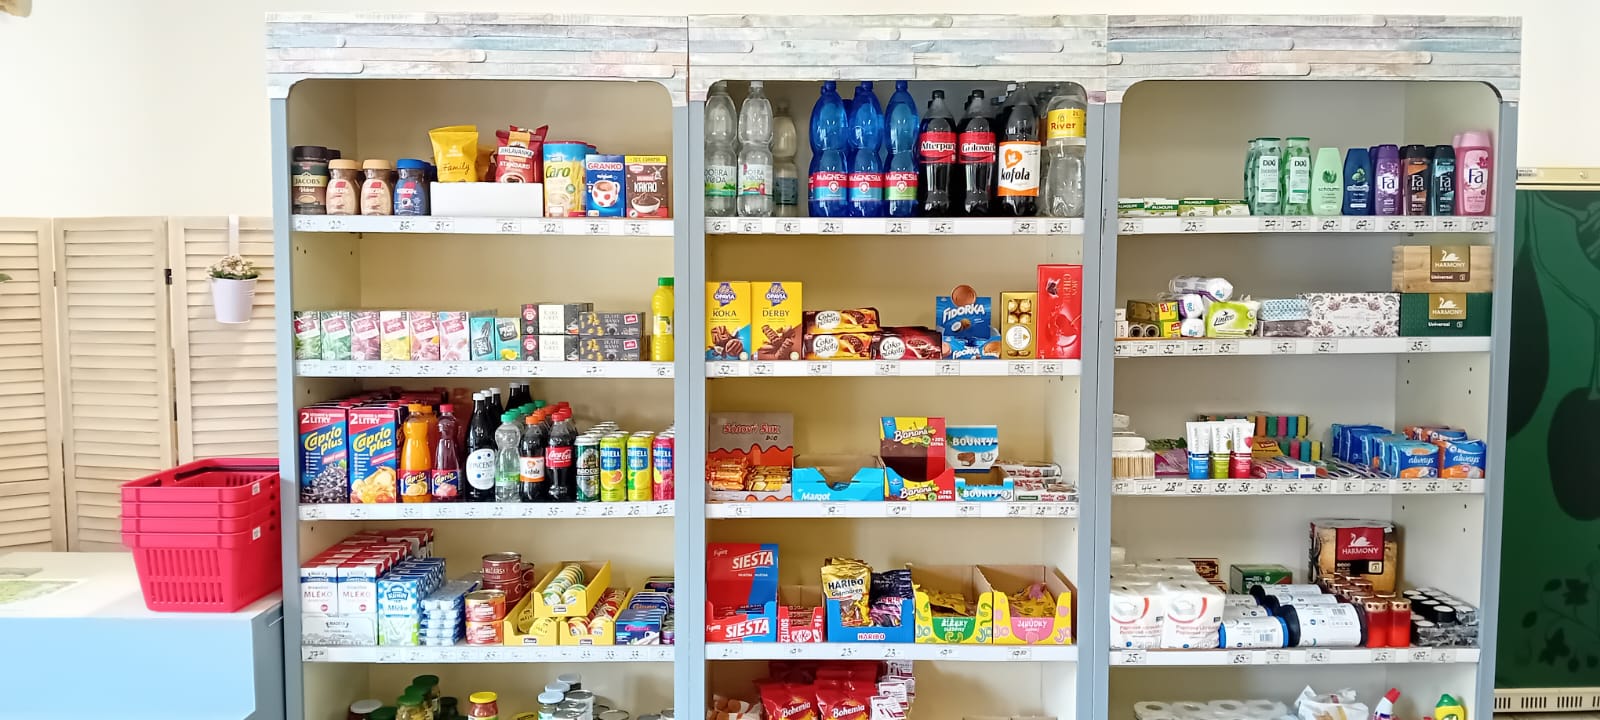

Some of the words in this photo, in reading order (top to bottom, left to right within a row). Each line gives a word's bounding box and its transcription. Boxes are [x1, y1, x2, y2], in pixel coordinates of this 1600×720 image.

[442, 162, 470, 174] Family
[545, 166, 570, 178] Caro
[588, 162, 622, 170] GRANKO
[1001, 167, 1030, 184] kofola
[1468, 168, 1484, 184] Fa
[634, 182, 658, 193] KAKAO
[1382, 176, 1396, 190] Fa
[1412, 176, 1424, 188] Fa
[1440, 176, 1452, 188] Fa
[712, 309, 736, 317] KOKA
[762, 309, 790, 317] DERBY
[942, 304, 986, 324] FIDORKA
[302, 412, 310, 424] 2
[350, 413, 358, 424] 2
[304, 426, 342, 451] Caprio
[352, 426, 391, 452] Caprio
[952, 438, 992, 446] BOUNTY
[320, 438, 344, 455] plus
[369, 438, 392, 456] plus
[1408, 455, 1434, 466] always
[1452, 454, 1480, 464] always
[800, 492, 830, 501] Margot
[963, 490, 998, 498] BOUNTY
[732, 550, 774, 570] SIESTA
[828, 578, 864, 590] HARIBO
[726, 619, 770, 638] SIESTA
[782, 702, 811, 718] Bohemia
[832, 704, 865, 718] Bohemia
